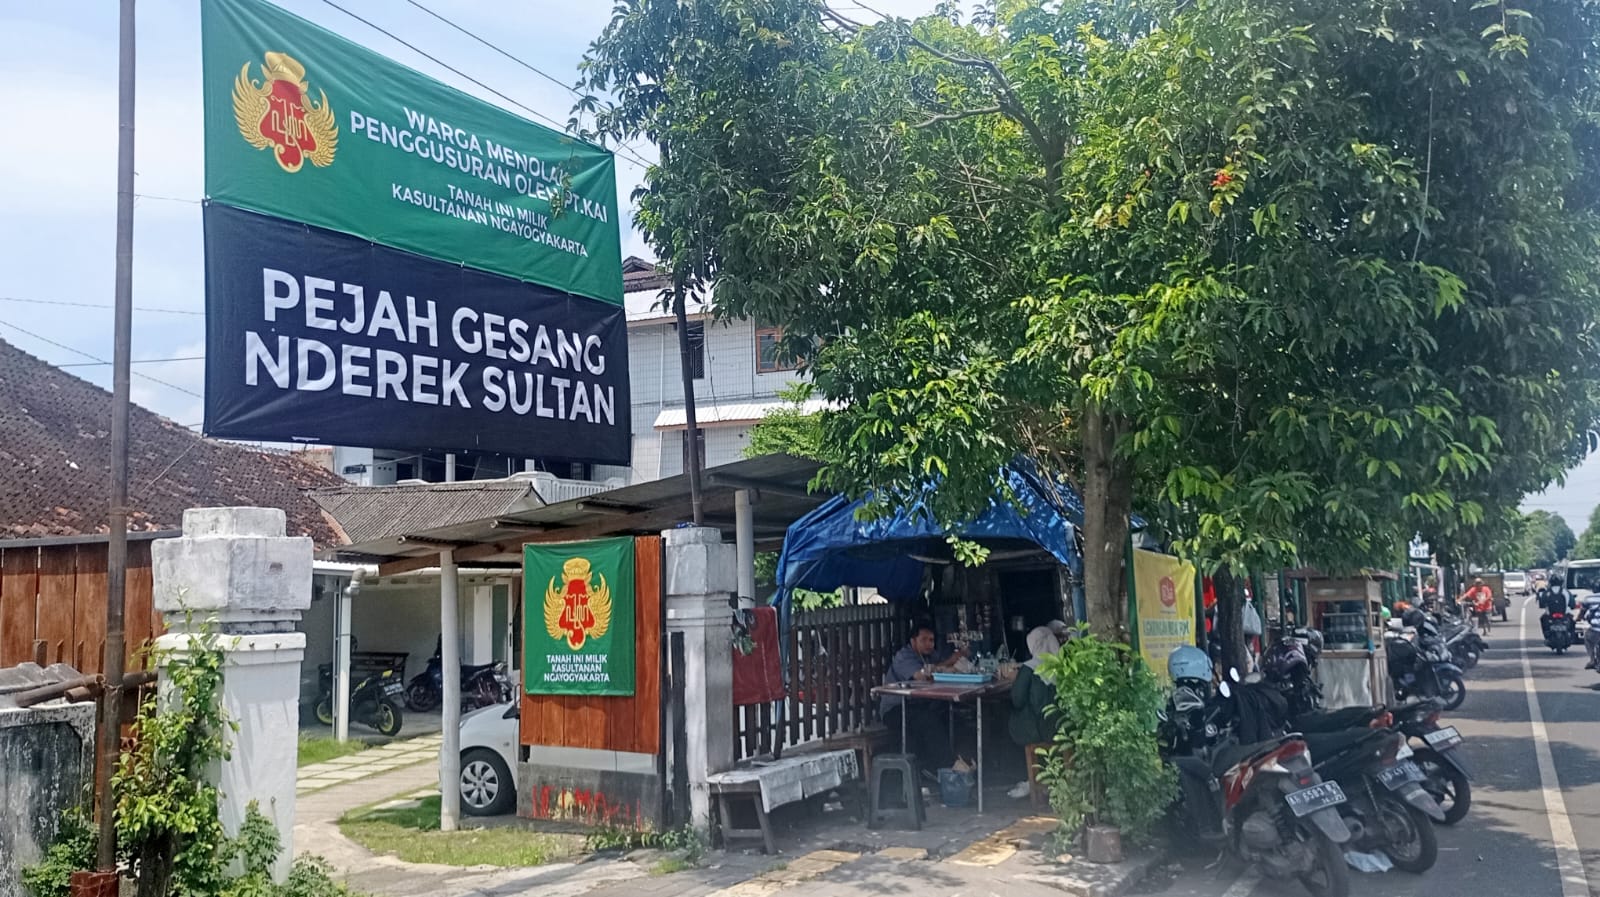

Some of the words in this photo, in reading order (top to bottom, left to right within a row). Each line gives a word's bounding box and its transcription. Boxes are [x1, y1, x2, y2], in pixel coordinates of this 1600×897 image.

[403, 106, 483, 156] WARGA
[350, 110, 511, 189] PENGGUSURAN
[564, 190, 608, 223] PT.KAI
[392, 183, 488, 226] KASULTANAN
[491, 215, 589, 258] NGAYOGYAKARTA
[448, 184, 493, 213] TANAH
[495, 202, 515, 219] INI
[517, 206, 548, 230] MILIK
[262, 267, 439, 348] PEJAH
[451, 306, 606, 375] GESANG
[245, 330, 471, 409] NDEREK
[482, 366, 615, 426] SULTAN
[544, 672, 610, 682] NGAYOGYAKARTA
[546, 654, 571, 664] TANAH
[572, 654, 584, 663] INI
[585, 654, 608, 663] MILIK
[551, 663, 602, 673] KASULTANAN
